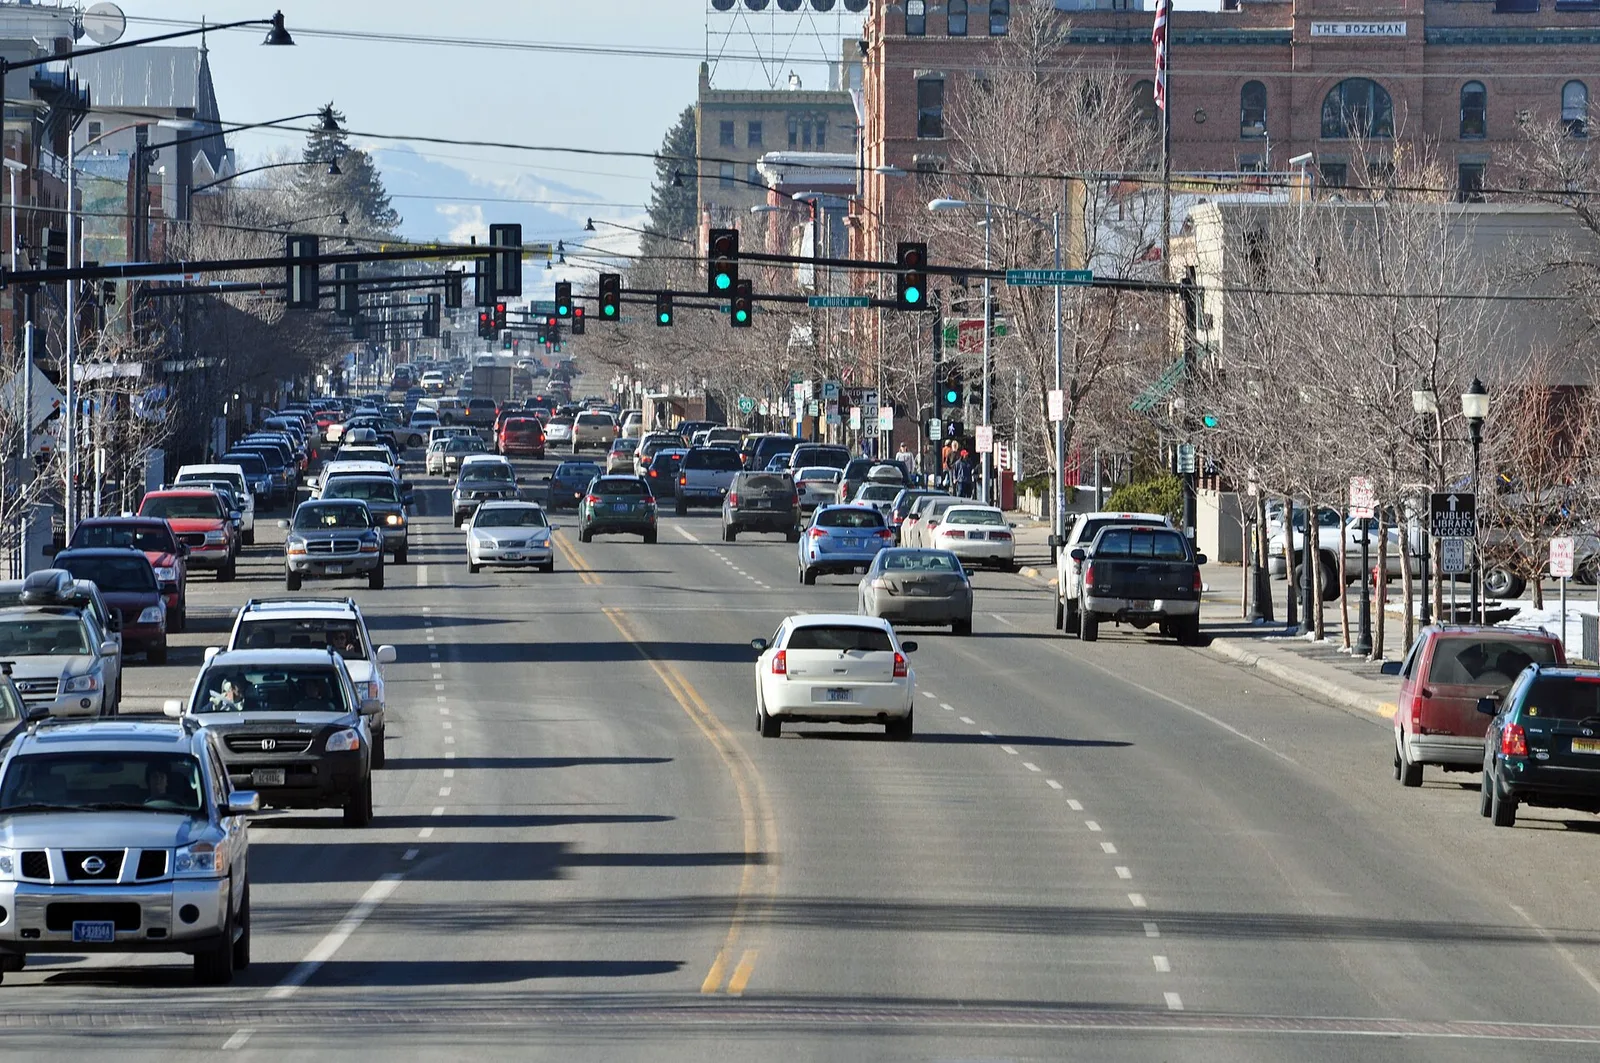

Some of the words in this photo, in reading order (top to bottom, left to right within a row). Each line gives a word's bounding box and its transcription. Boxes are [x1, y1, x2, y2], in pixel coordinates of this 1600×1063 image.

[1315, 24, 1338, 34] THE
[1345, 24, 1402, 34] BOZEMAN
[1024, 271, 1066, 284] WALLACE
[1074, 274, 1087, 282] AVE
[822, 297, 849, 307] CHURCH
[824, 383, 835, 396] P
[741, 401, 752, 410] 90
[1435, 511, 1471, 520] PUBLIC
[1432, 519, 1474, 528] LIBRARY
[1434, 527, 1472, 536] ACCESS
